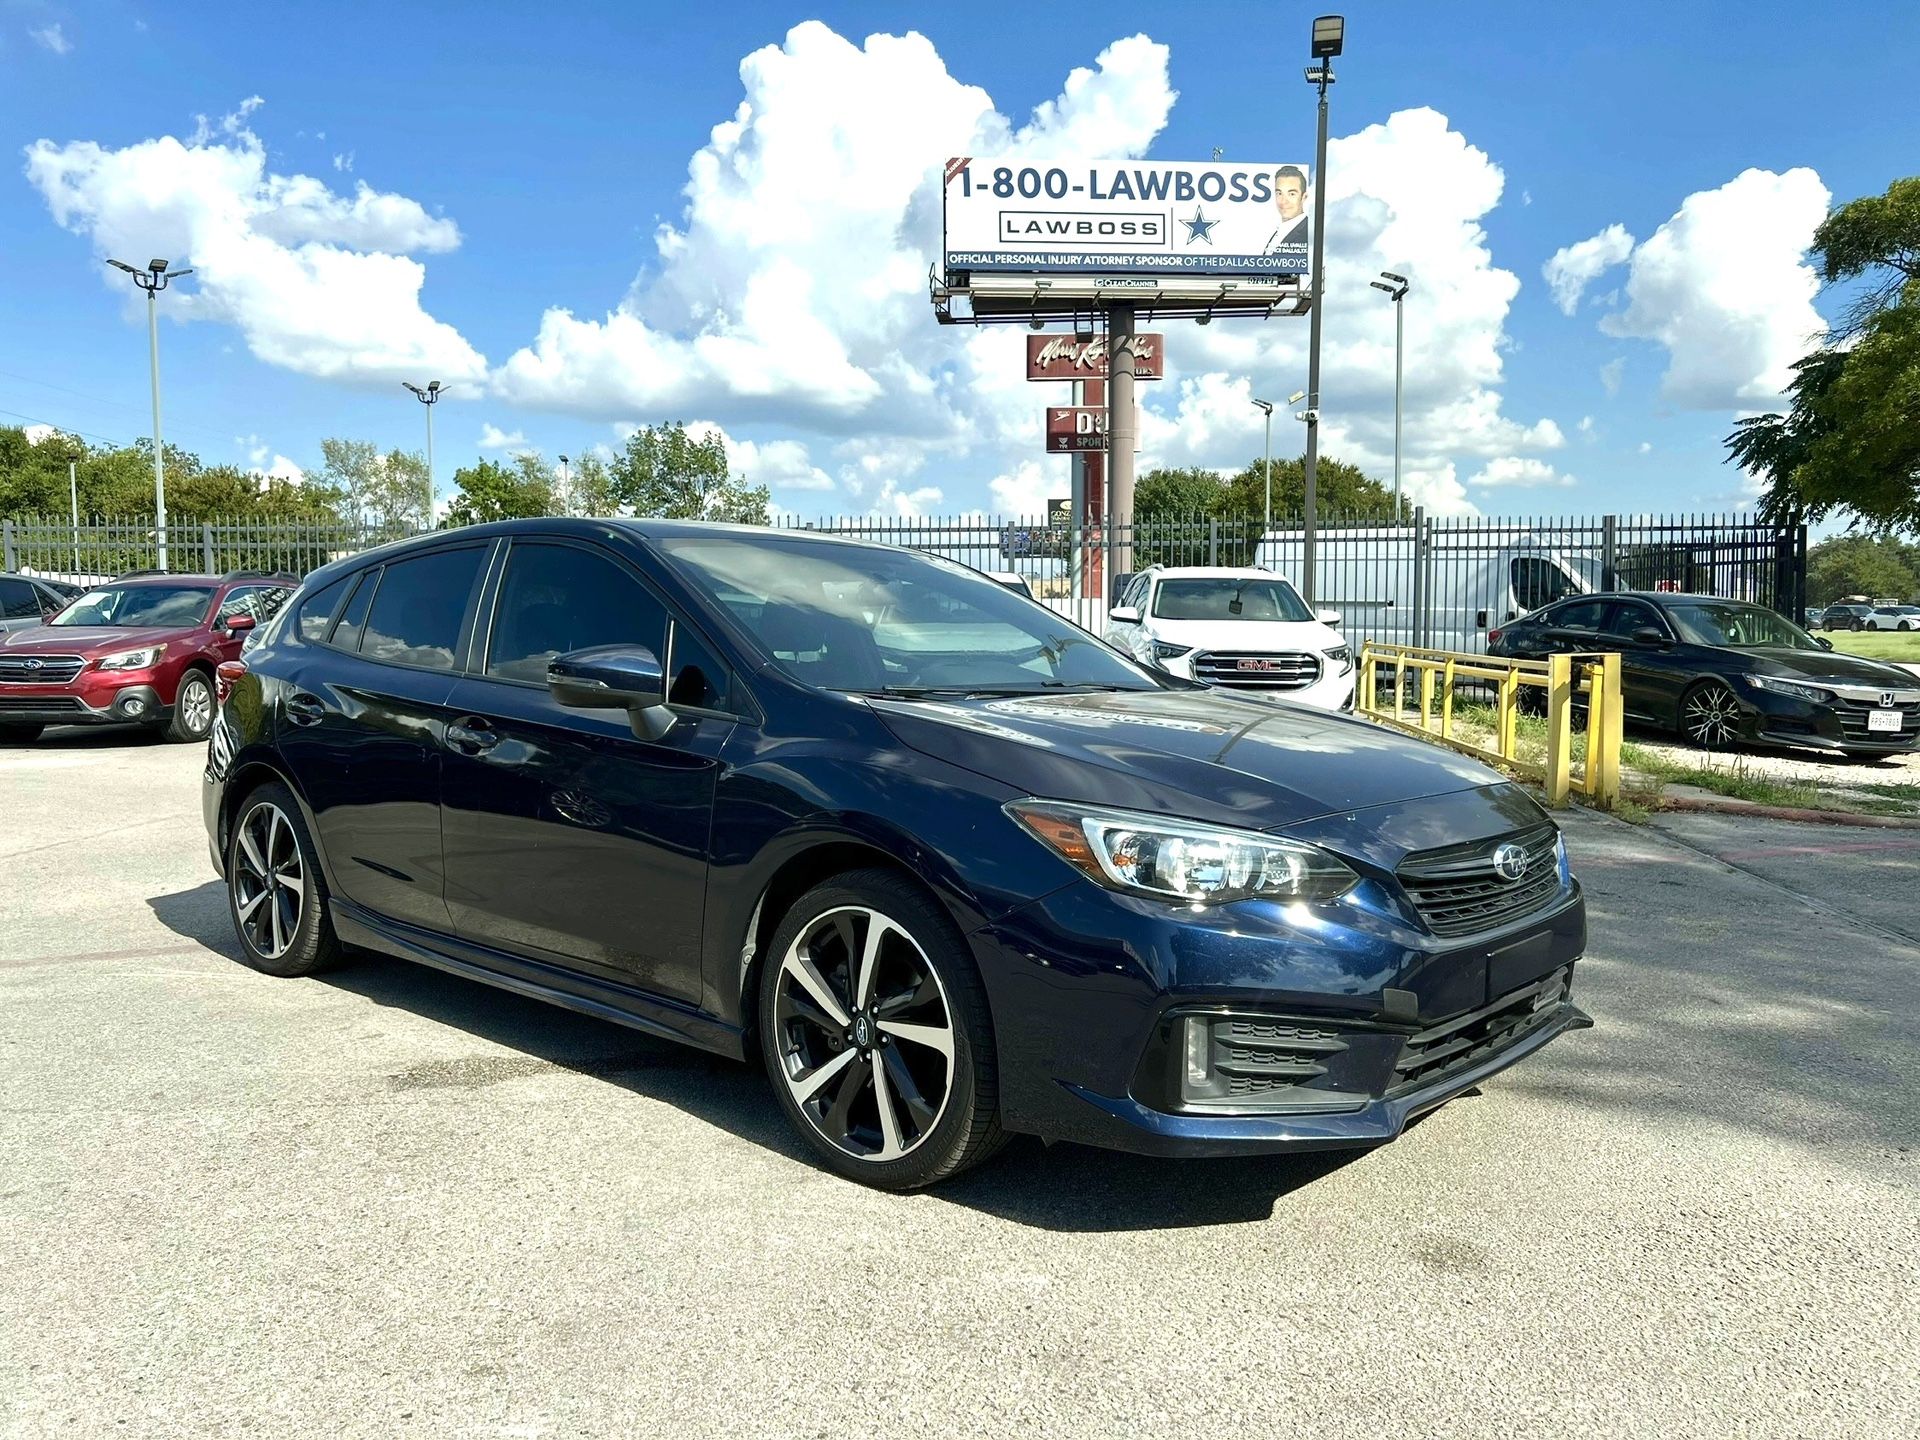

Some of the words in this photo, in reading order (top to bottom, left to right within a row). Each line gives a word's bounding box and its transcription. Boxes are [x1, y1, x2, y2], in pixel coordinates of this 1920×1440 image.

[961, 167, 1272, 203] 1-800-LAWBOSS
[1007, 220, 1158, 236] LAWBOSS
[949, 254, 994, 264] OFFICIAL
[995, 254, 1047, 265] PERSONAL
[1048, 255, 1083, 265] INJURY
[1083, 255, 1135, 265] ATTORNEY
[1135, 256, 1183, 266] SPONSOR
[1184, 257, 1198, 266] OF
[1199, 257, 1218, 267] THE
[1219, 257, 1255, 267] DALLAS
[1256, 258, 1307, 268] COWBOYS
[1237, 659, 1281, 671] GMC
